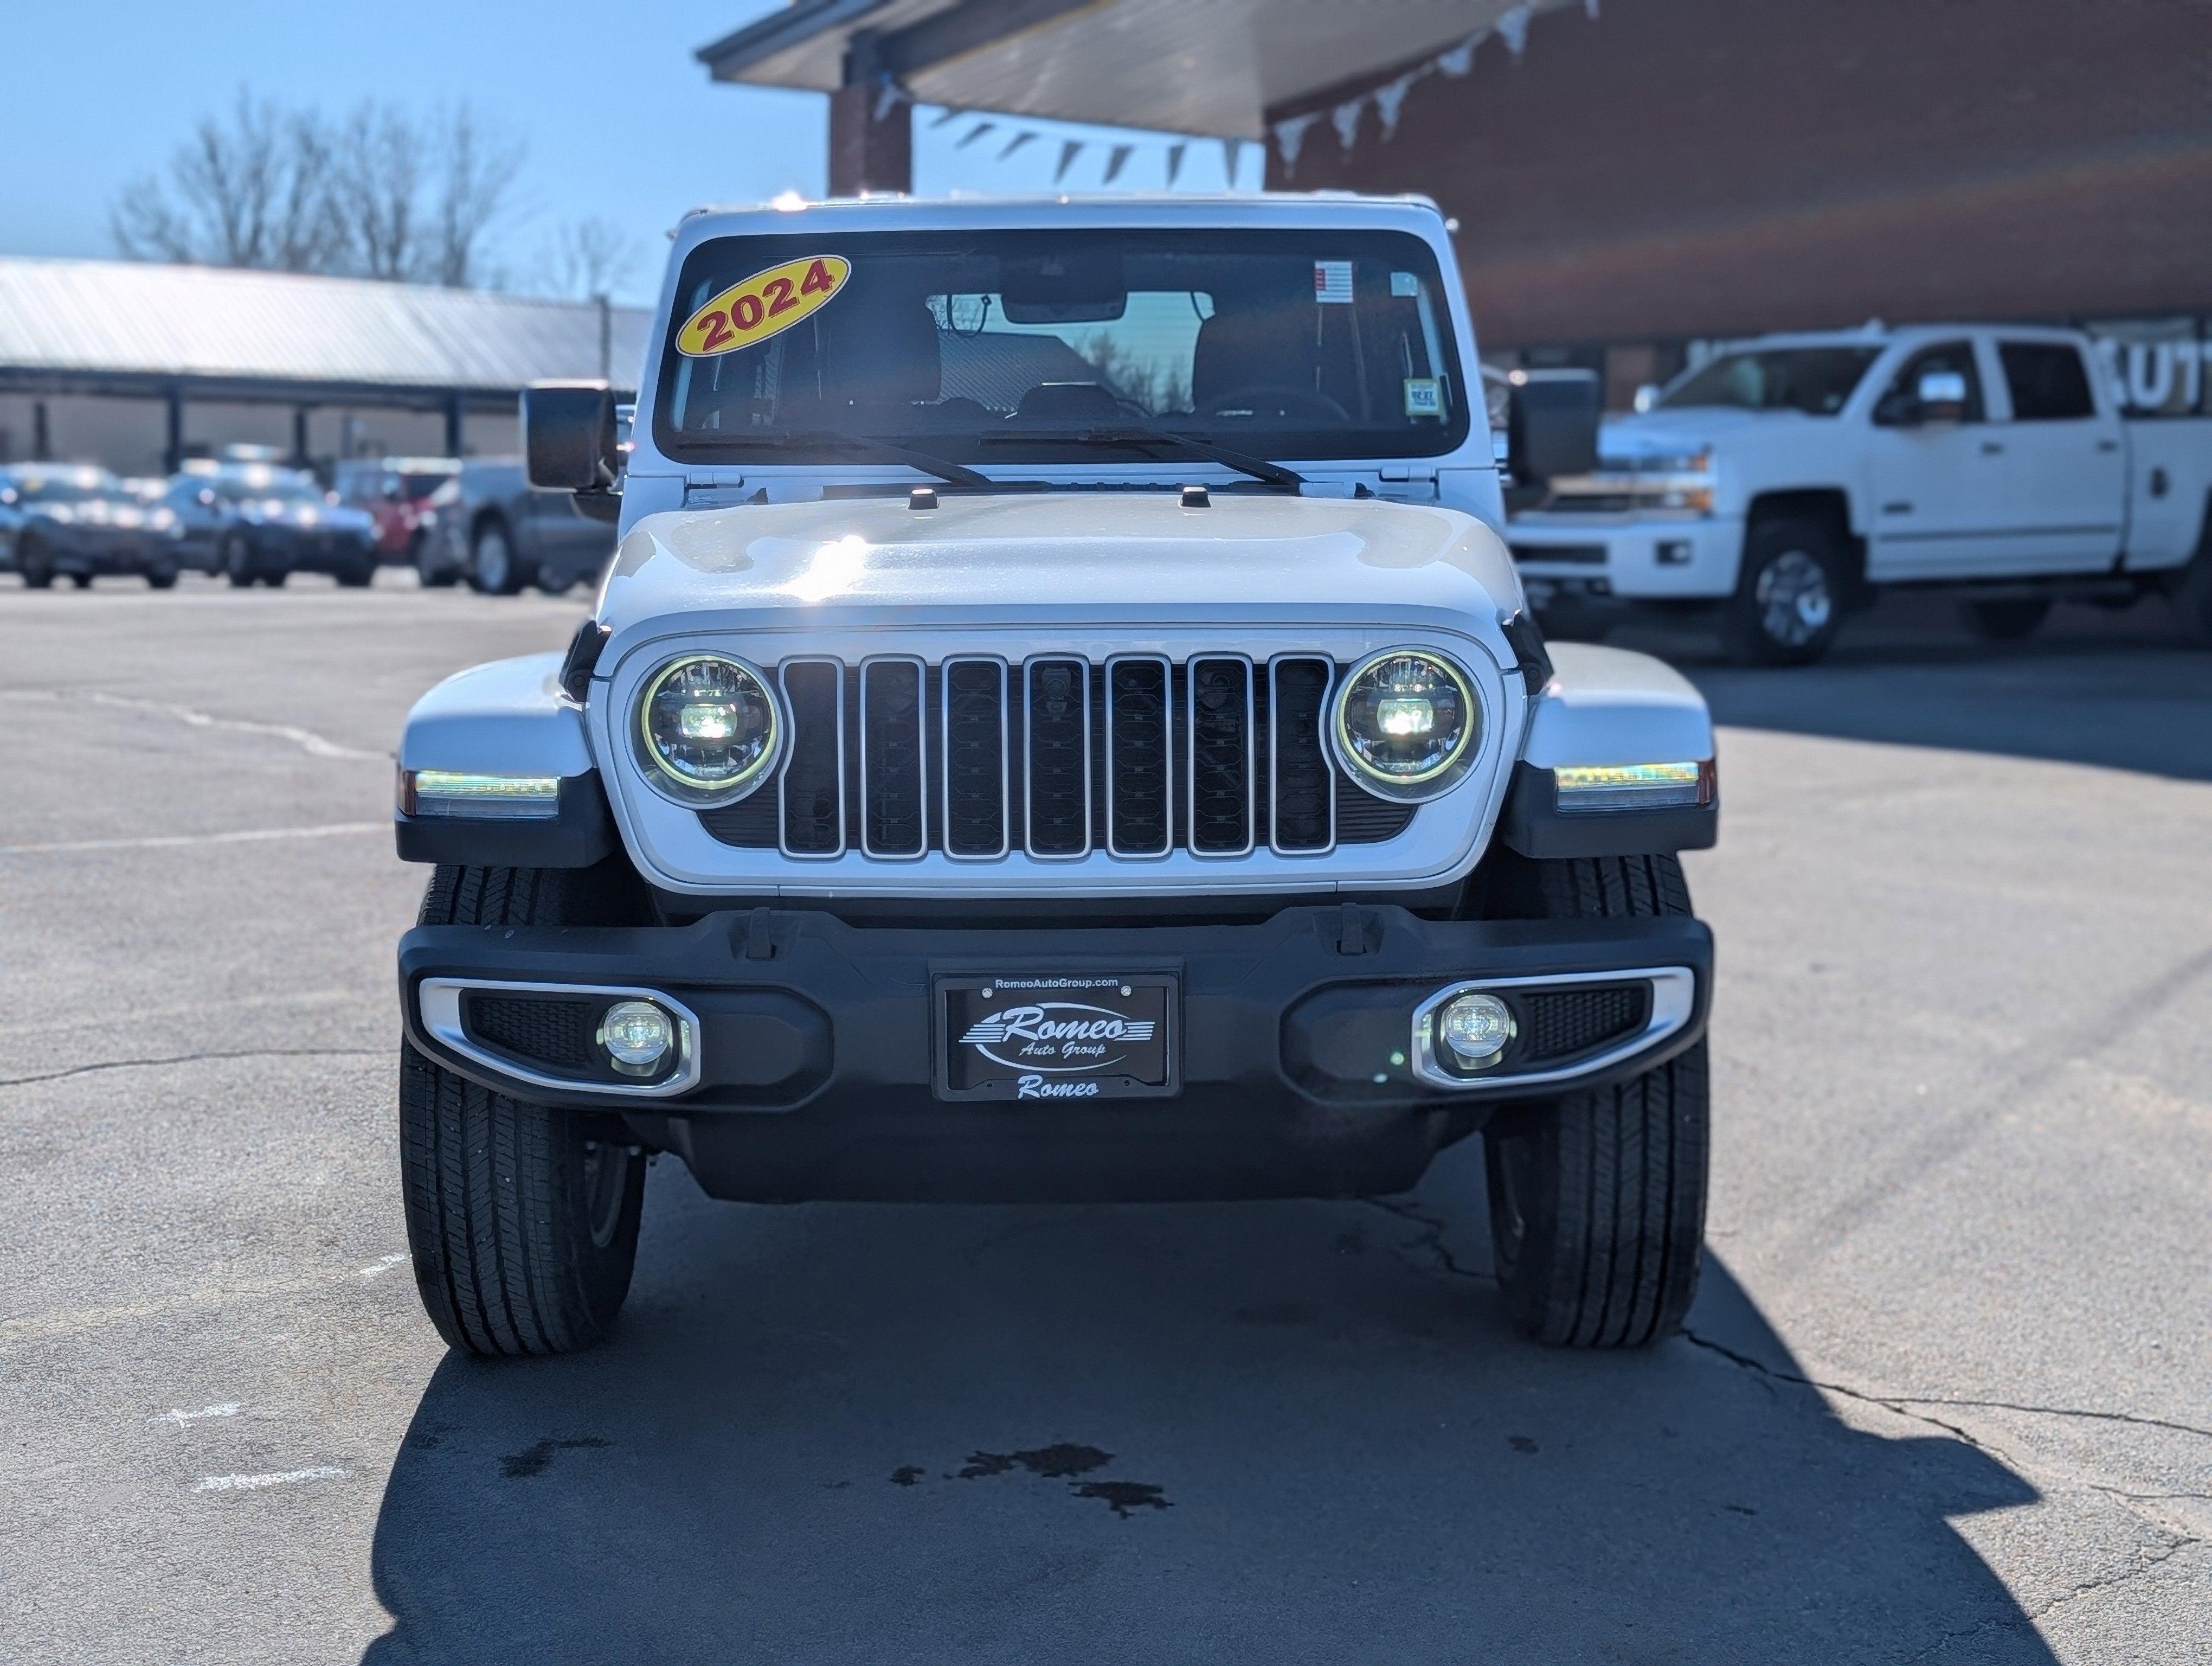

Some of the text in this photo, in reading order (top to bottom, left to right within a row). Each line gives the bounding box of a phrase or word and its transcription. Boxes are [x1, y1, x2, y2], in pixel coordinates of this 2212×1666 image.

[697, 259, 835, 352] 2024
[995, 978, 1118, 989] RomeoAutoGroup.com
[1002, 1007, 1127, 1042] Romeo
[1018, 1041, 1107, 1059] Auto Group
[1018, 1075, 1099, 1099] Romeo
